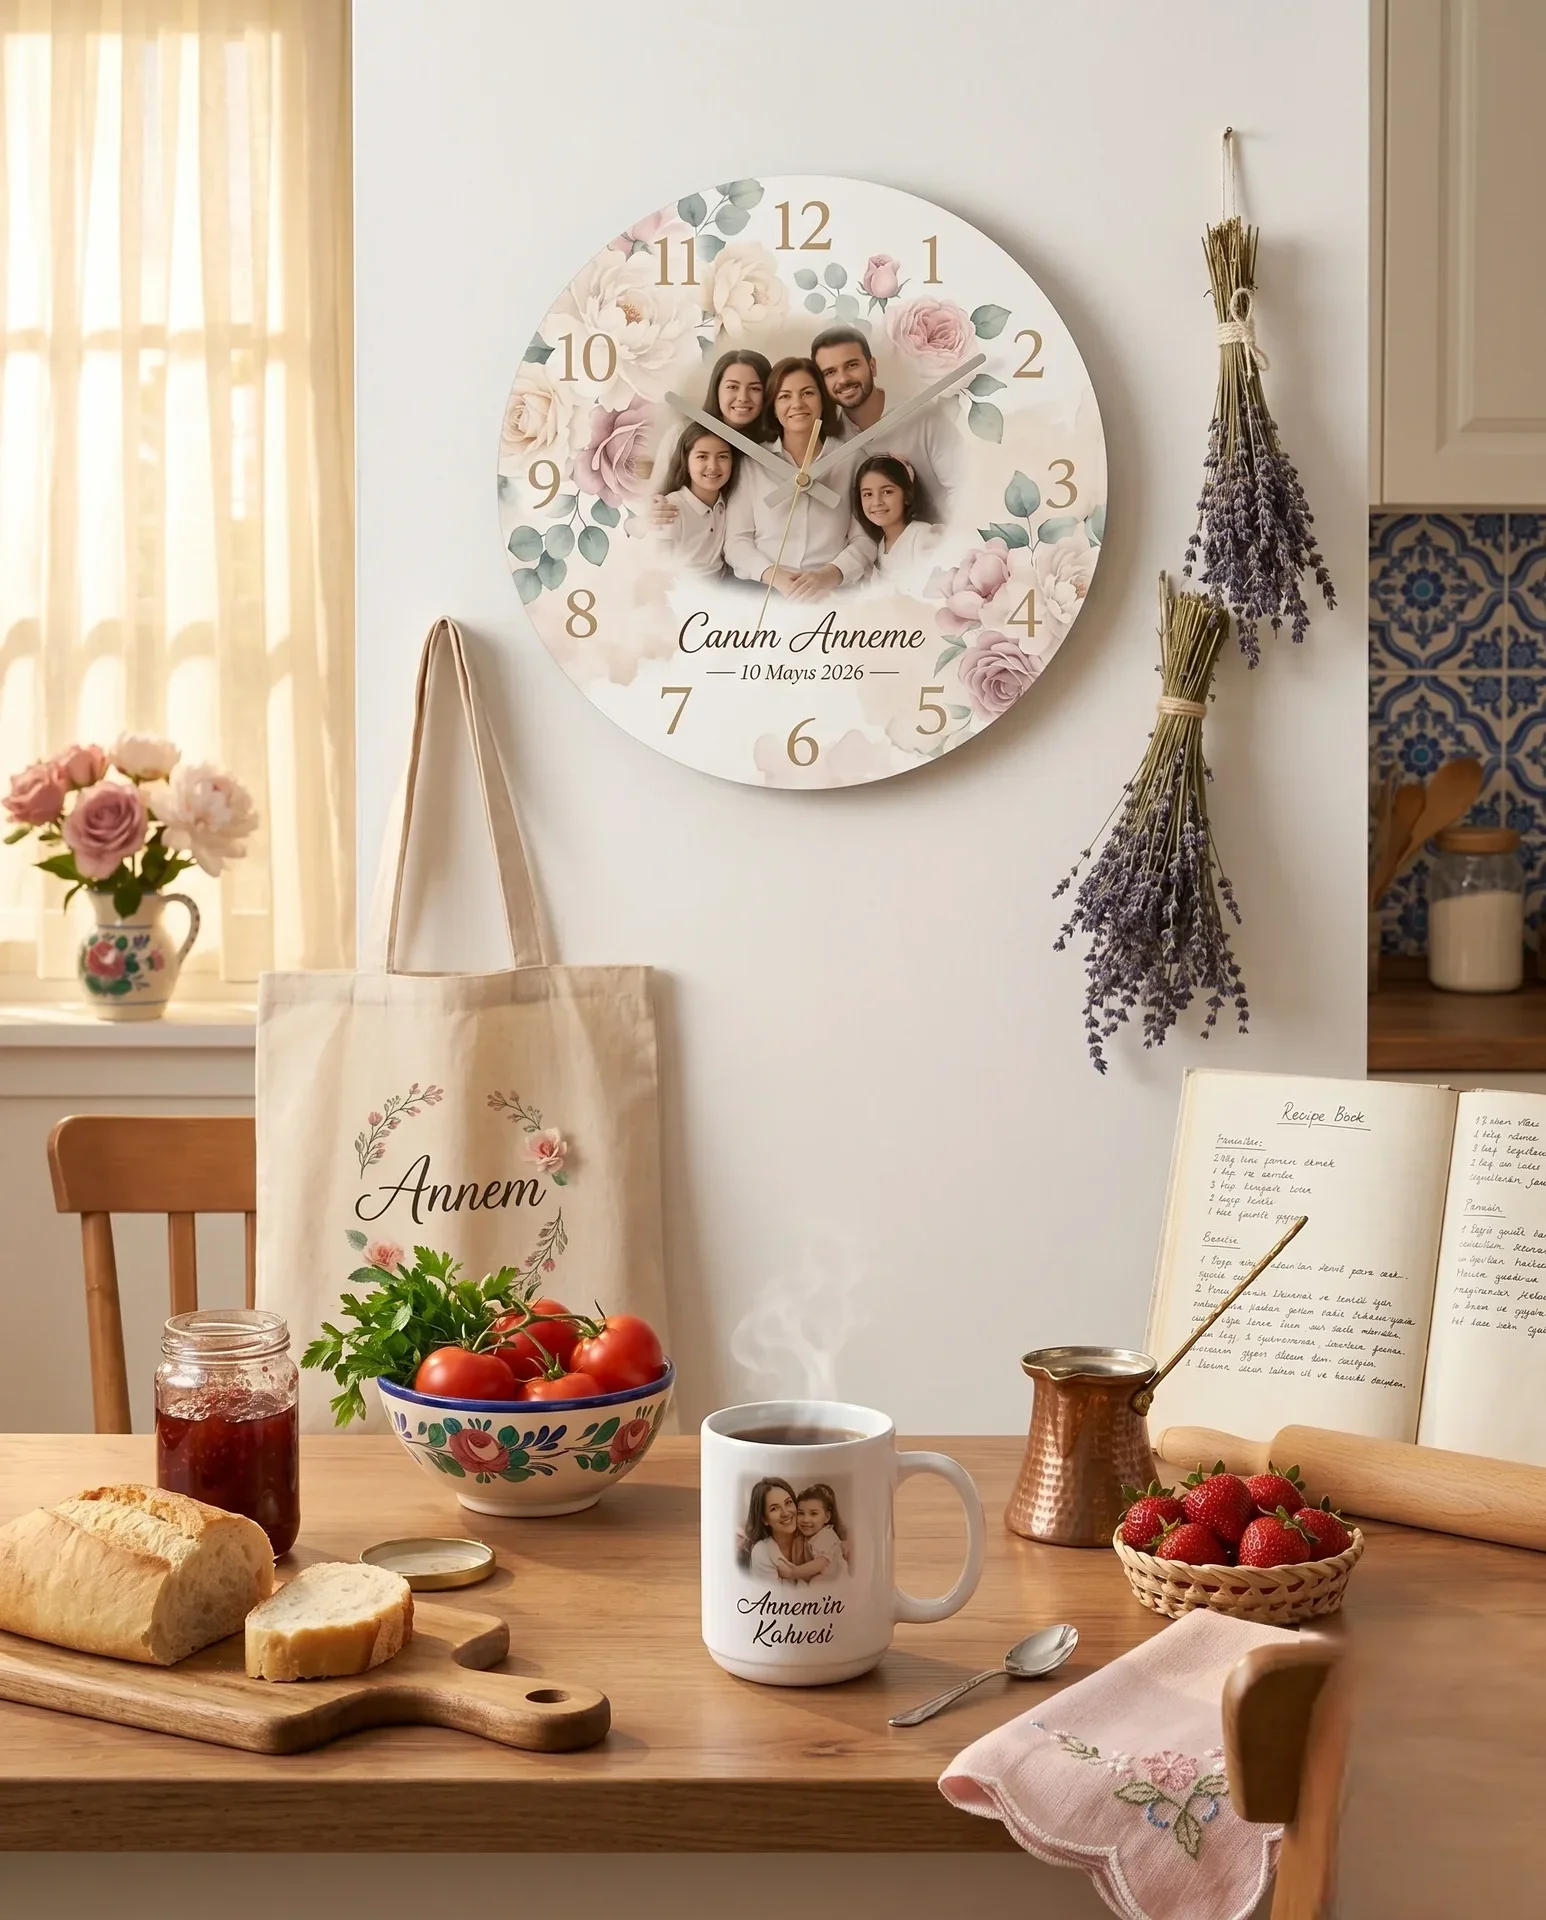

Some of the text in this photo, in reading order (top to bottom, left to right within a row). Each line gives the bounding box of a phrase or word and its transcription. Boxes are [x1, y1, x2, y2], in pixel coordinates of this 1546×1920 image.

[775, 200, 832, 250] 12
[654, 236, 700, 286] 11
[922, 235, 943, 284] 1
[558, 333, 617, 382] 10
[1013, 330, 1045, 379] 2
[528, 459, 561, 509] 9
[1045, 458, 1078, 509] 3
[565, 589, 598, 638] 8
[678, 610, 926, 654] Canım Anneme
[1007, 588, 1043, 638] 4
[740, 664, 864, 685] 10 Mayıs 2026
[660, 686, 693, 735] 7
[916, 686, 947, 735] 5
[787, 718, 819, 766] 6
[1282, 1101, 1326, 1128] Recipe
[355, 1154, 547, 1225] Annem
[736, 1590, 846, 1616] Annem'in
[752, 1619, 835, 1648] Kahvesi
